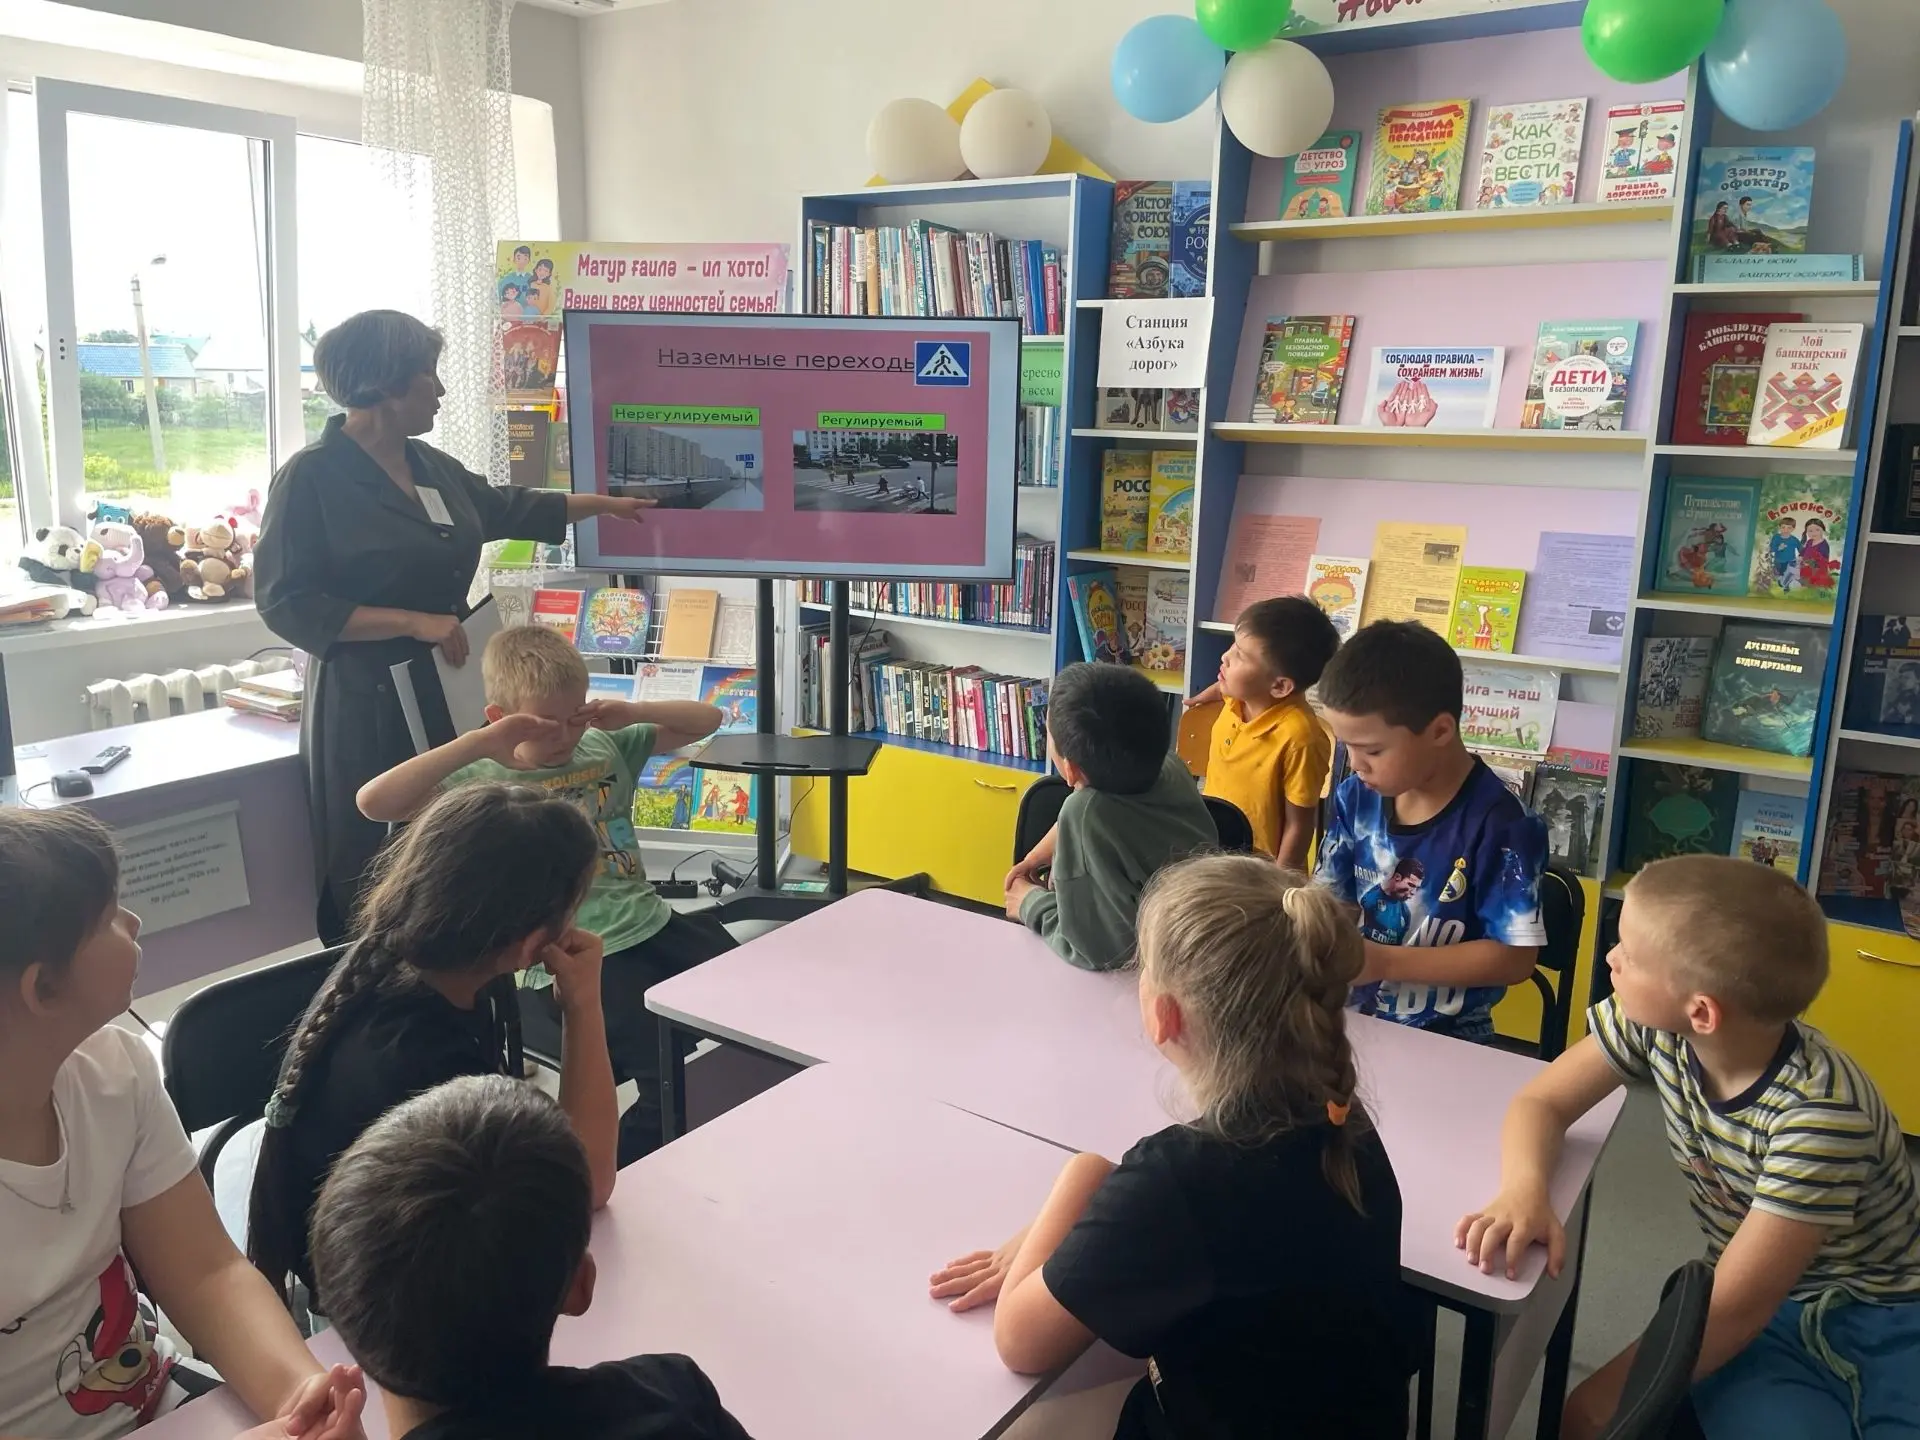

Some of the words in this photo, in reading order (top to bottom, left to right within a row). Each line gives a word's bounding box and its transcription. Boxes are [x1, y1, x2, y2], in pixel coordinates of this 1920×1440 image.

[1512, 122, 1553, 140] КАК
[1300, 150, 1343, 161] ДЕТСТВО
[1504, 142, 1557, 160] СЕБЯ
[1314, 160, 1344, 169] УГРОЗ
[1495, 163, 1560, 181] ВЕСТИ
[1605, 187, 1667, 198] ДОРОЖНОГО
[1615, 182, 1659, 191] ПРАВИЛА
[577, 254, 626, 283] Матур
[702, 259, 724, 277] ил
[564, 288, 607, 311] Венец
[612, 294, 643, 311] всех
[649, 289, 724, 312] ценностей
[729, 290, 778, 312] семья!
[1126, 314, 1188, 330] Станция
[1126, 336, 1184, 353] «Азбука
[1801, 336, 1823, 347] Мой
[658, 348, 786, 369] Наземные
[1386, 353, 1432, 365] СОБЛЮДАЯ
[1434, 354, 1475, 364] ПРАВИЛА
[1775, 348, 1847, 361] башкирский
[1129, 357, 1178, 373] дорог»
[1790, 360, 1820, 370] язык
[1397, 367, 1447, 378] СОХРАНЯЕМ
[1449, 367, 1484, 378] ЖИЗНЬ!
[1550, 370, 1607, 386] ДЕТИ
[614, 407, 754, 424] Нерегулируемый
[822, 414, 924, 429] Регулируемый
[1511, 581, 1520, 594] 2
[1760, 660, 1803, 674] ДРУЗЬЯМИ
[1508, 688, 1541, 702] наш
